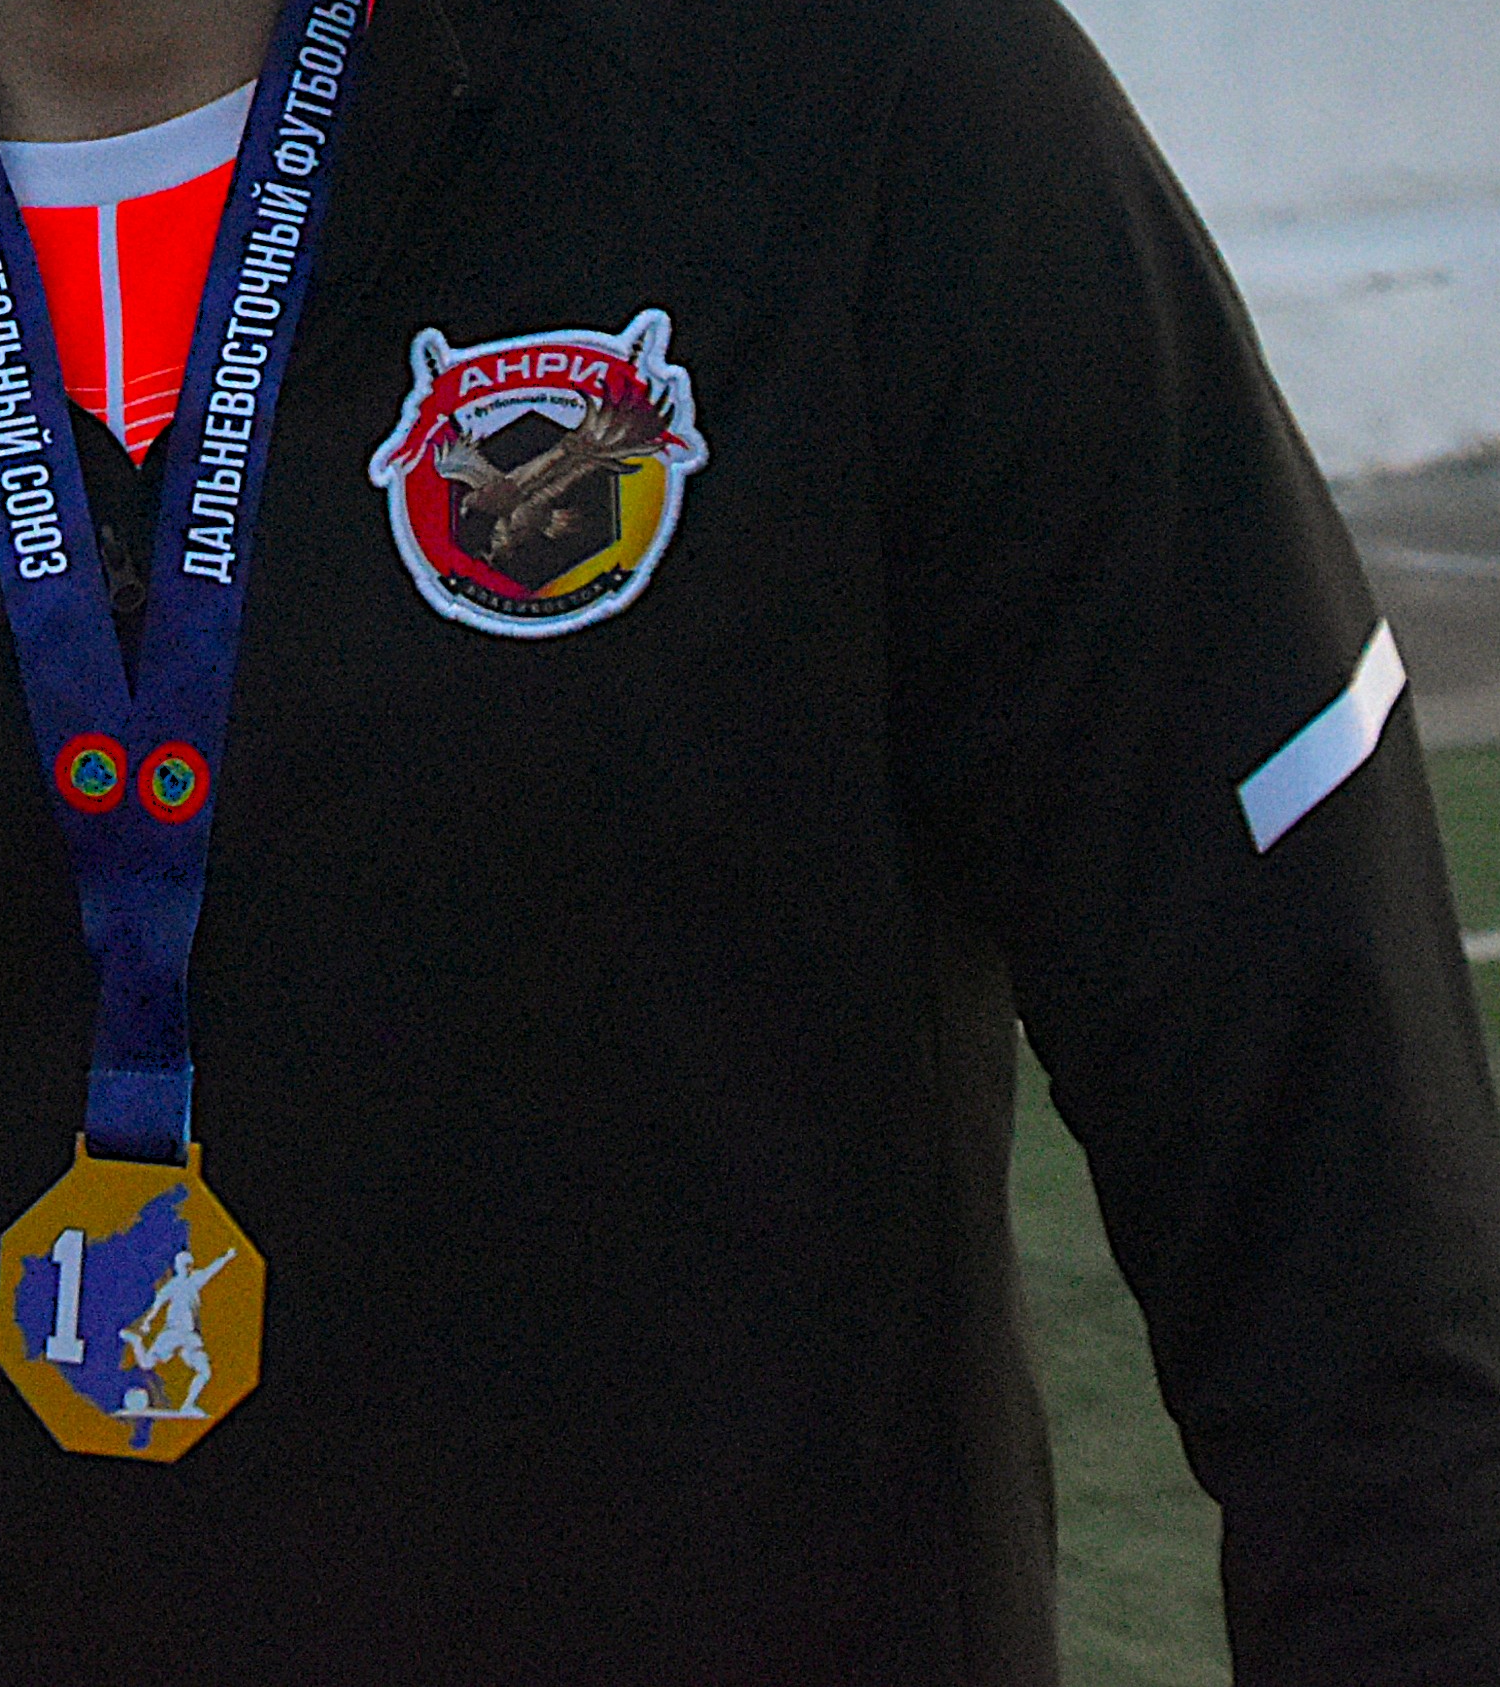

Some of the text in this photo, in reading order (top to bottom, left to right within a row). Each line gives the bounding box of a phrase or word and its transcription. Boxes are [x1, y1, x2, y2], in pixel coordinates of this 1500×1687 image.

[183, 182, 312, 584] ДАЛЬНЕВОСТОЧНЫЙ
[459, 353, 608, 396] АНРИ
[1, 464, 68, 579] СОЮЗ
[46, 1228, 84, 1363] 1
